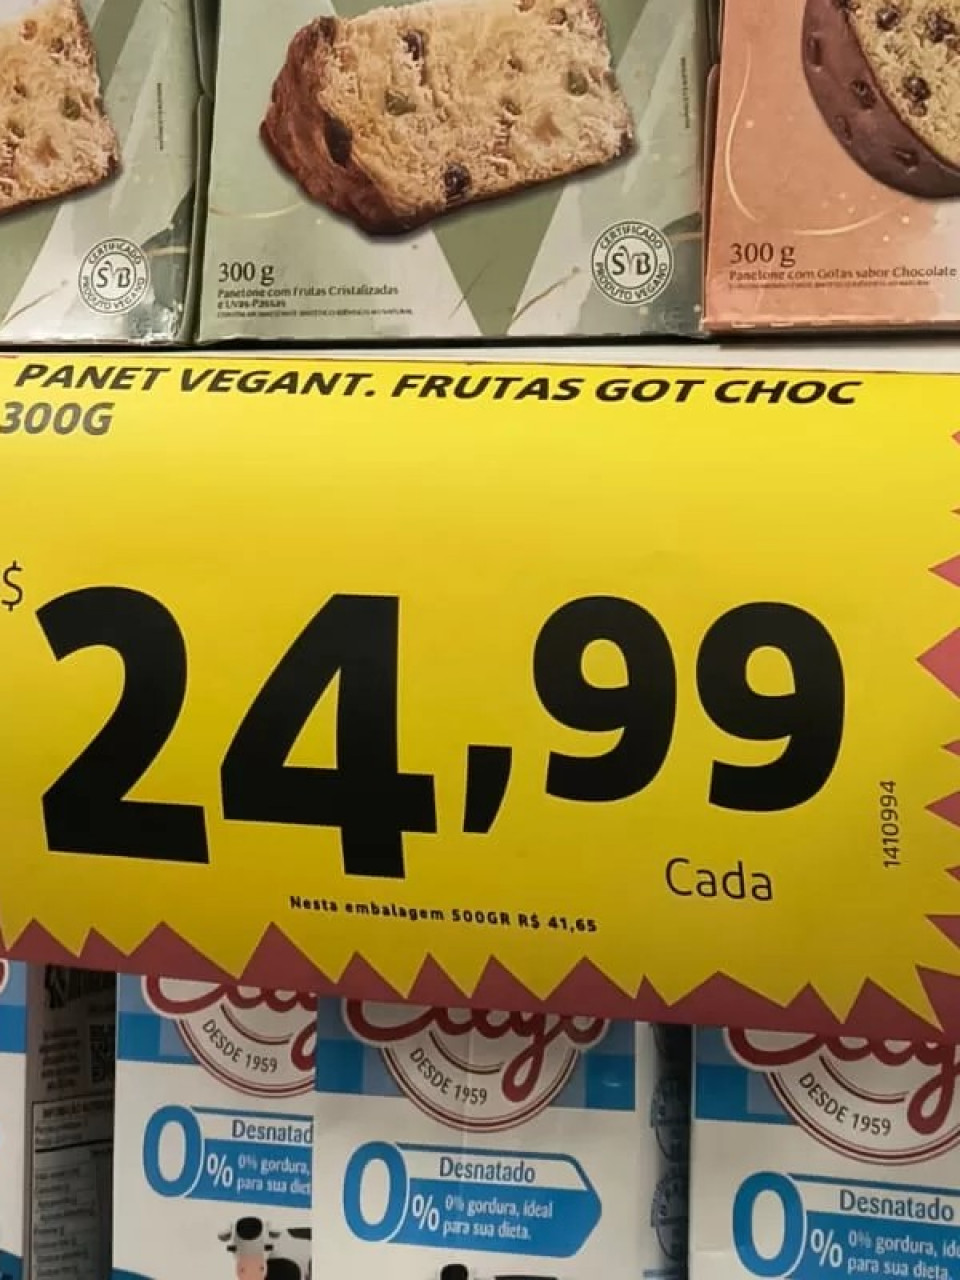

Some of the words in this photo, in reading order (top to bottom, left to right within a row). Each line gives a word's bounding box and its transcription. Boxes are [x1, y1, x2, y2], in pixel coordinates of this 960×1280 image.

[730, 242, 774, 264] 300
[780, 245, 796, 267] g
[218, 261, 256, 283] 300
[260, 264, 275, 286] g
[15, 364, 171, 391] PANET
[179, 368, 376, 398] VEGANT.
[392, 373, 584, 401] FRUTAS
[595, 378, 705, 403] GOT
[714, 380, 862, 405] CHOC
[34, 585, 846, 880] 24,99
[879, 780, 901, 869] 1410994
[665, 857, 773, 901] Cada
[290, 896, 337, 912] Nesta
[346, 901, 444, 922] embalagem
[452, 909, 511, 926] 500GR
[518, 912, 540, 930] R$
[548, 916, 597, 934] 41,65
[202, 1020, 242, 1061] DESDE
[245, 1053, 278, 1073] 1959
[410, 1047, 450, 1093] DESDE
[453, 1084, 488, 1106] 1959
[799, 1072, 846, 1123] DESDE
[851, 1112, 891, 1137] 1959
[260, 1156, 310, 1177] gordura,
[440, 1156, 536, 1183] Desnatado
[236, 1178, 263, 1195] para
[467, 1198, 520, 1218] gordura,
[523, 1200, 552, 1218] ideal
[840, 1189, 954, 1221] Desnatado
[443, 1221, 470, 1238] para
[472, 1223, 494, 1236] sua
[497, 1223, 531, 1240] dieta.
[875, 1235, 937, 1257] gordura,
[847, 1257, 879, 1275] para
[883, 1262, 908, 1276] sua
